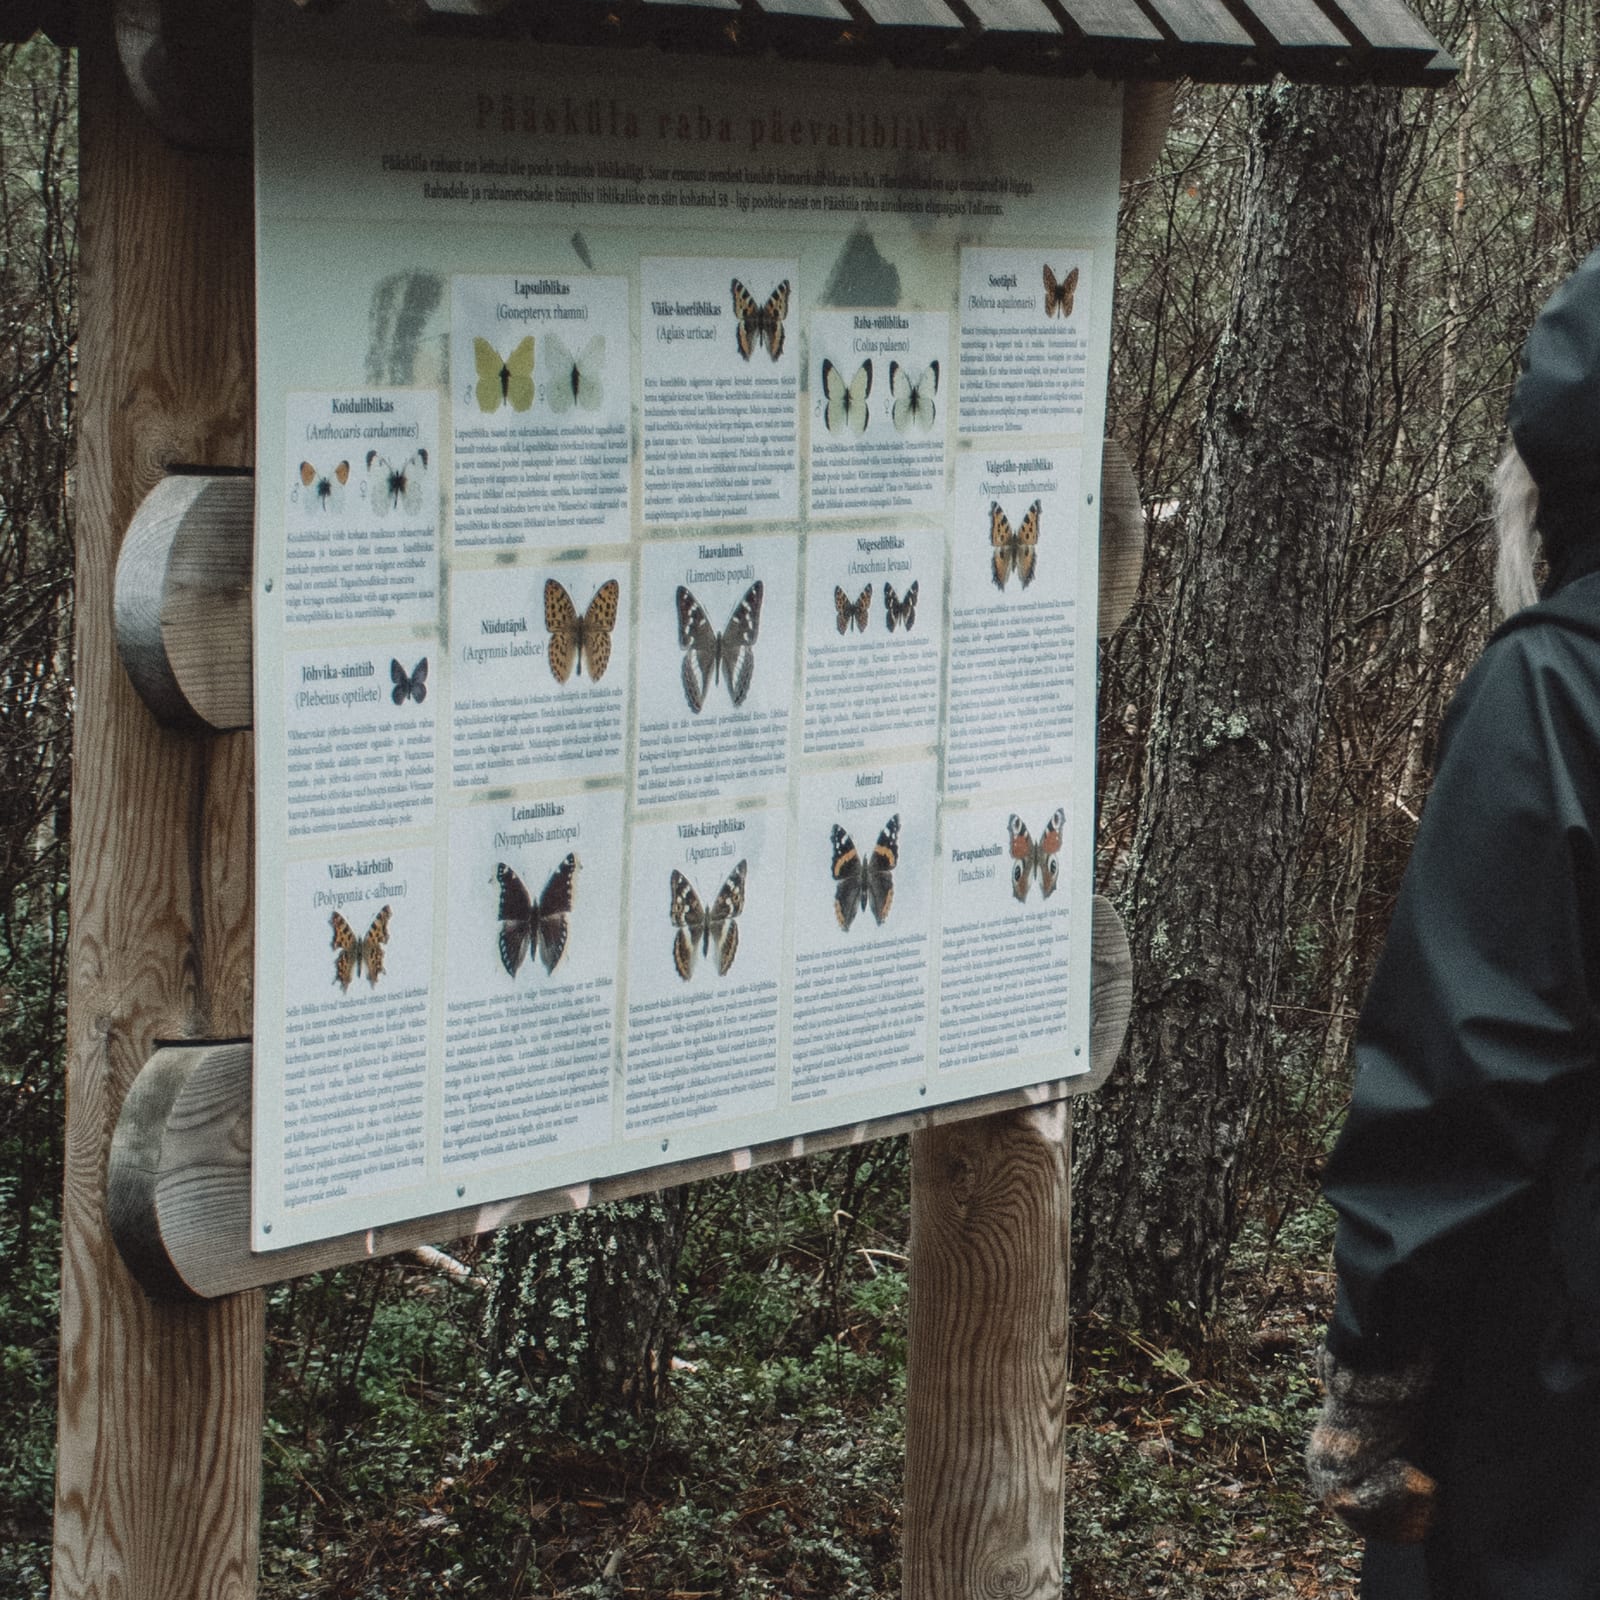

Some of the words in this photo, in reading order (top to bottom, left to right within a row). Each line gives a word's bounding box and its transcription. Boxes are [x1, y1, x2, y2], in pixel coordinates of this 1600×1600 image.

[476, 93, 638, 139] Pääsküla
[659, 104, 732, 142] raba
[424, 182, 469, 199] Rabadele
[470, 184, 480, 204] ja
[483, 185, 553, 202] rabametsadele
[647, 192, 659, 204] on
[679, 190, 716, 207] kohatud
[515, 280, 570, 296] Lapsuliblikas
[497, 303, 551, 323] (Gonepteryx
[651, 301, 721, 317] Väike-koerliblikas
[657, 325, 684, 344] (Aglais
[686, 324, 717, 341] urticae)
[332, 398, 394, 414] Koiduliblikas
[306, 422, 360, 441] (Anthocaris
[363, 421, 419, 439] cardamines)
[699, 543, 743, 560] Haavalumik
[686, 568, 725, 585] (Limenitis
[481, 618, 528, 636] Niidutäpik
[463, 645, 507, 664] (Argynnis
[510, 640, 545, 658] laodice)
[302, 661, 375, 683] Jõhvika-sinitiib
[296, 691, 339, 710] (Plebeius
[341, 685, 382, 708] optilete)
[855, 771, 883, 787] Admiral
[512, 804, 564, 822] Leinaliblikas
[494, 827, 543, 849] (Nymphalis
[546, 824, 580, 845] antiopa)
[677, 818, 746, 839] Väike-kiirgliblikas
[327, 857, 394, 880] Väike-kärbtiib
[313, 885, 363, 909] (Polygonia
[365, 880, 407, 902] c-album)
